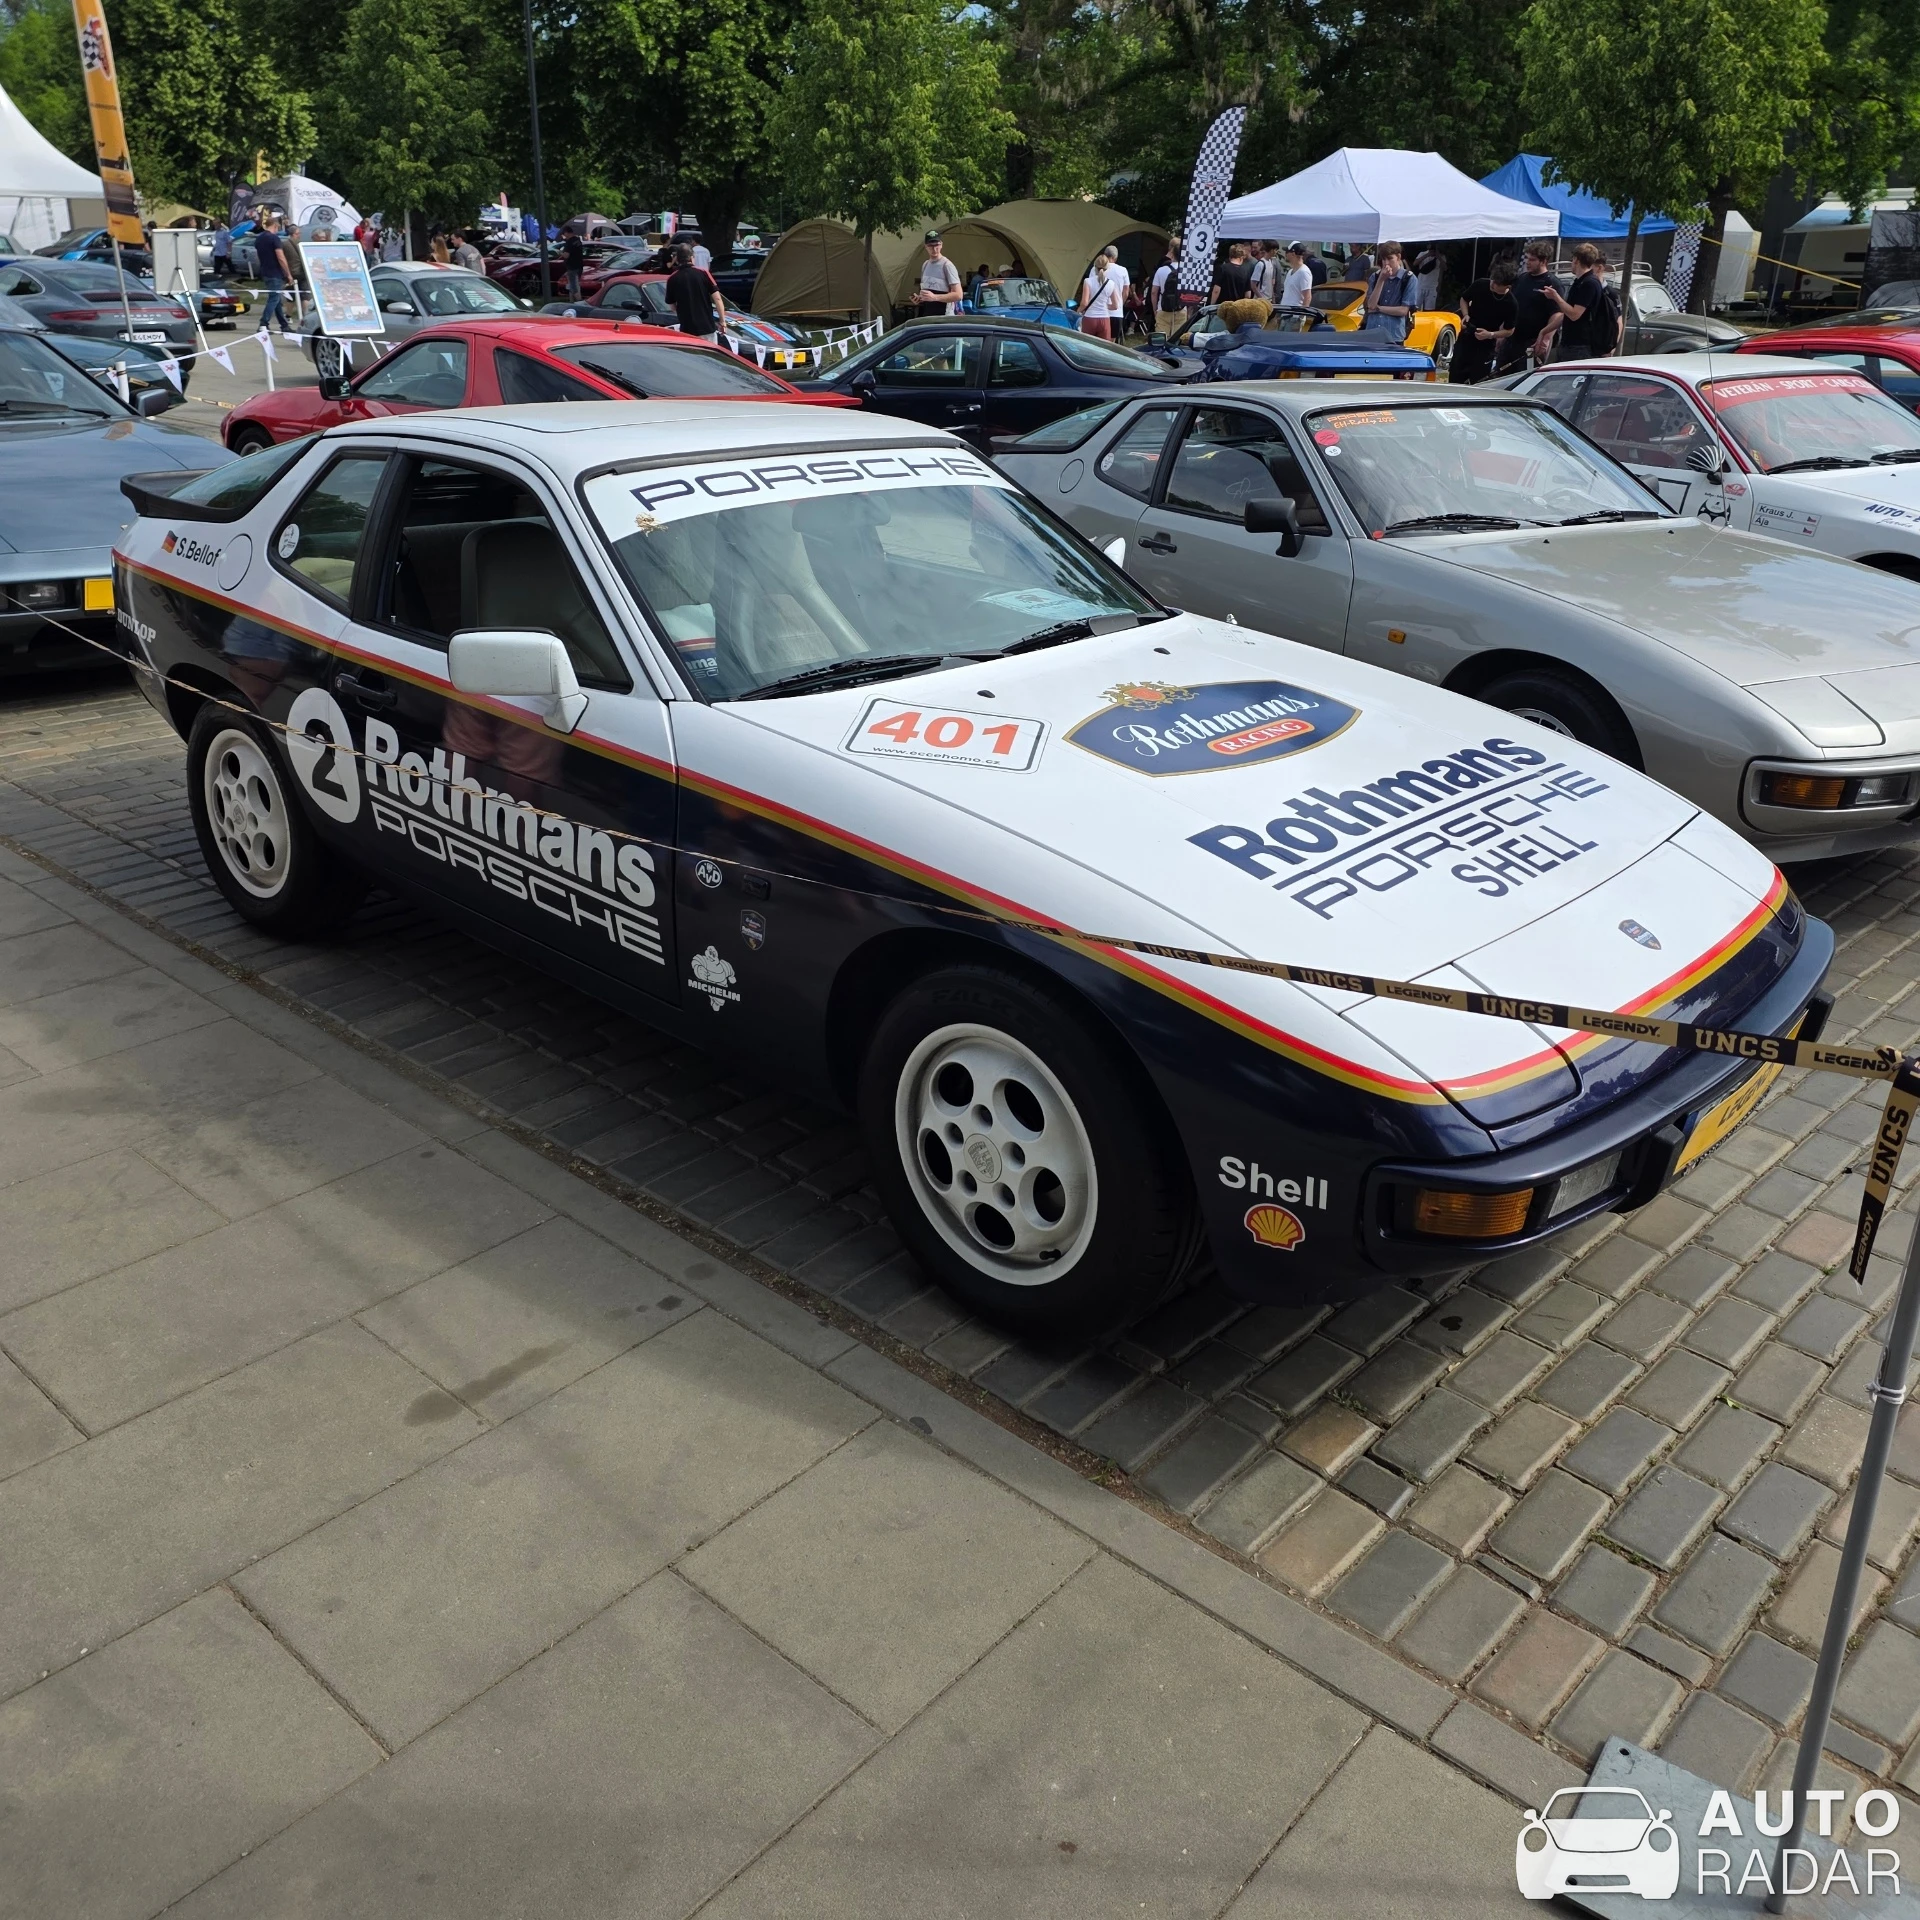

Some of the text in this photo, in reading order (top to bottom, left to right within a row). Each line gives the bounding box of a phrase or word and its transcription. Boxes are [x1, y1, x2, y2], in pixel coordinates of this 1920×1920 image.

[1195, 231, 1208, 252] 3
[1677, 255, 1686, 269] 1
[1714, 381, 1775, 399] VETERÁN
[1781, 378, 1819, 391] SPORT
[1327, 411, 1393, 423] PORSCHE
[629, 458, 992, 512] PORSCHE
[1755, 514, 1770, 527] Ája
[1759, 505, 1795, 520] Kraus J.
[1863, 503, 1906, 518] AUTO
[176, 537, 222, 568] S.Bellof
[117, 607, 157, 643] DUNLOP
[867, 711, 1020, 756] 401
[1112, 694, 1320, 757] Rothmans
[1219, 720, 1304, 752] RACING
[304, 718, 349, 803] 2
[873, 746, 1001, 766] www.eccehomo.cz
[365, 716, 656, 908] Rothmans
[1184, 738, 1547, 881] Rothmans
[1290, 769, 1611, 921] PORSCHE
[1451, 825, 1600, 898] SHELL
[371, 800, 666, 966] PORSCHE
[688, 978, 741, 1002] MICHELIN
[1144, 943, 1202, 963] UNCS
[1301, 969, 1364, 993] UNCS
[1481, 995, 1555, 1024] UNCS
[1695, 1028, 1780, 1060] UNCS
[1813, 1050, 1891, 1073] LEGEND
[1218, 1155, 1329, 1210] Shell
[1853, 1104, 1910, 1281] EGENDY UNCS
